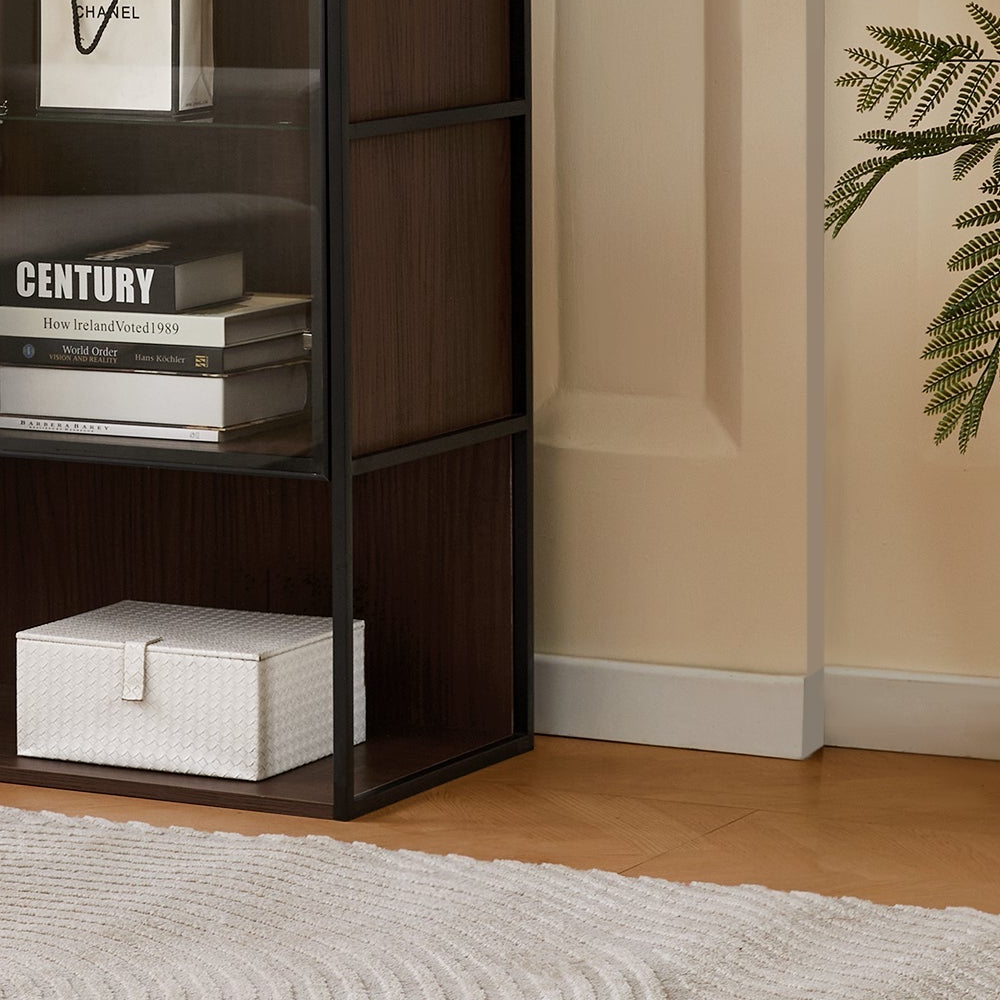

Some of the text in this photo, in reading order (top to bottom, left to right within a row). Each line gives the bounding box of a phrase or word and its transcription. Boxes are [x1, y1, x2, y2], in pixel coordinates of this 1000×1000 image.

[76, 5, 140, 19] CHANEL
[16, 260, 155, 304] CENTURY
[43, 317, 70, 330] How
[62, 345, 118, 357] World Order
[89, 356, 118, 364] REALITY
[135, 353, 154, 362] Hans
